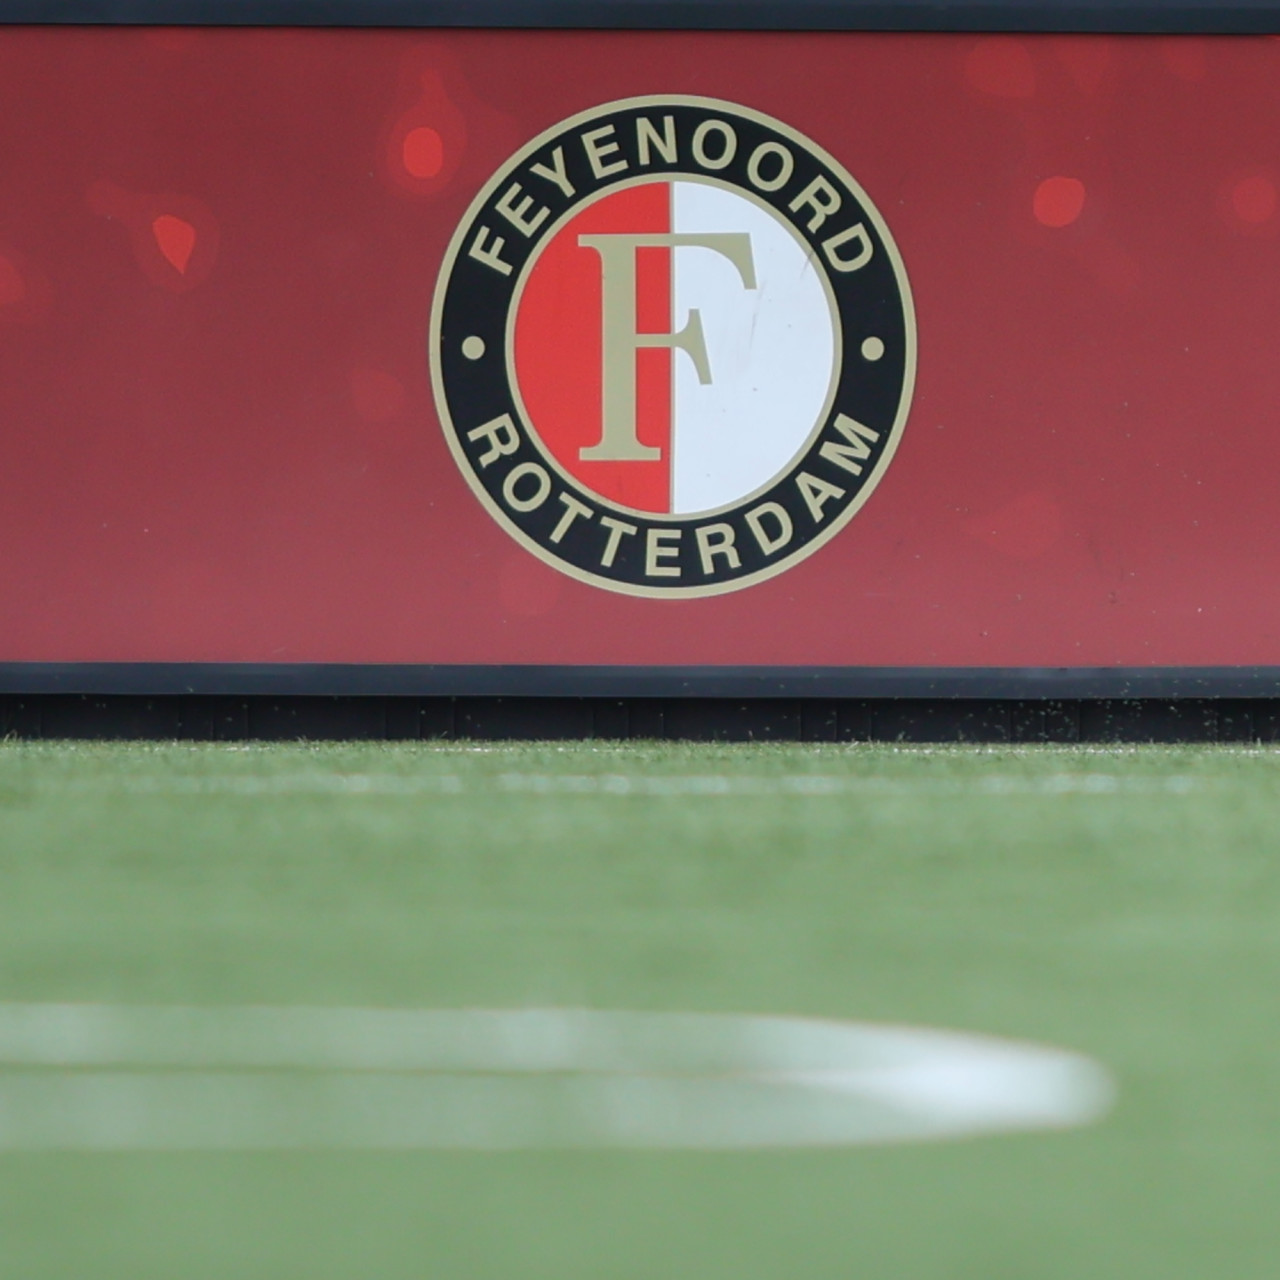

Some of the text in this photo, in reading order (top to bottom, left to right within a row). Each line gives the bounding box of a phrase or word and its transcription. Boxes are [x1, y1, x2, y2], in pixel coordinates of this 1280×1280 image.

[467, 115, 874, 277] FEYENOORD
[577, 231, 757, 461] F
[467, 413, 880, 577] ROTTERDAM
